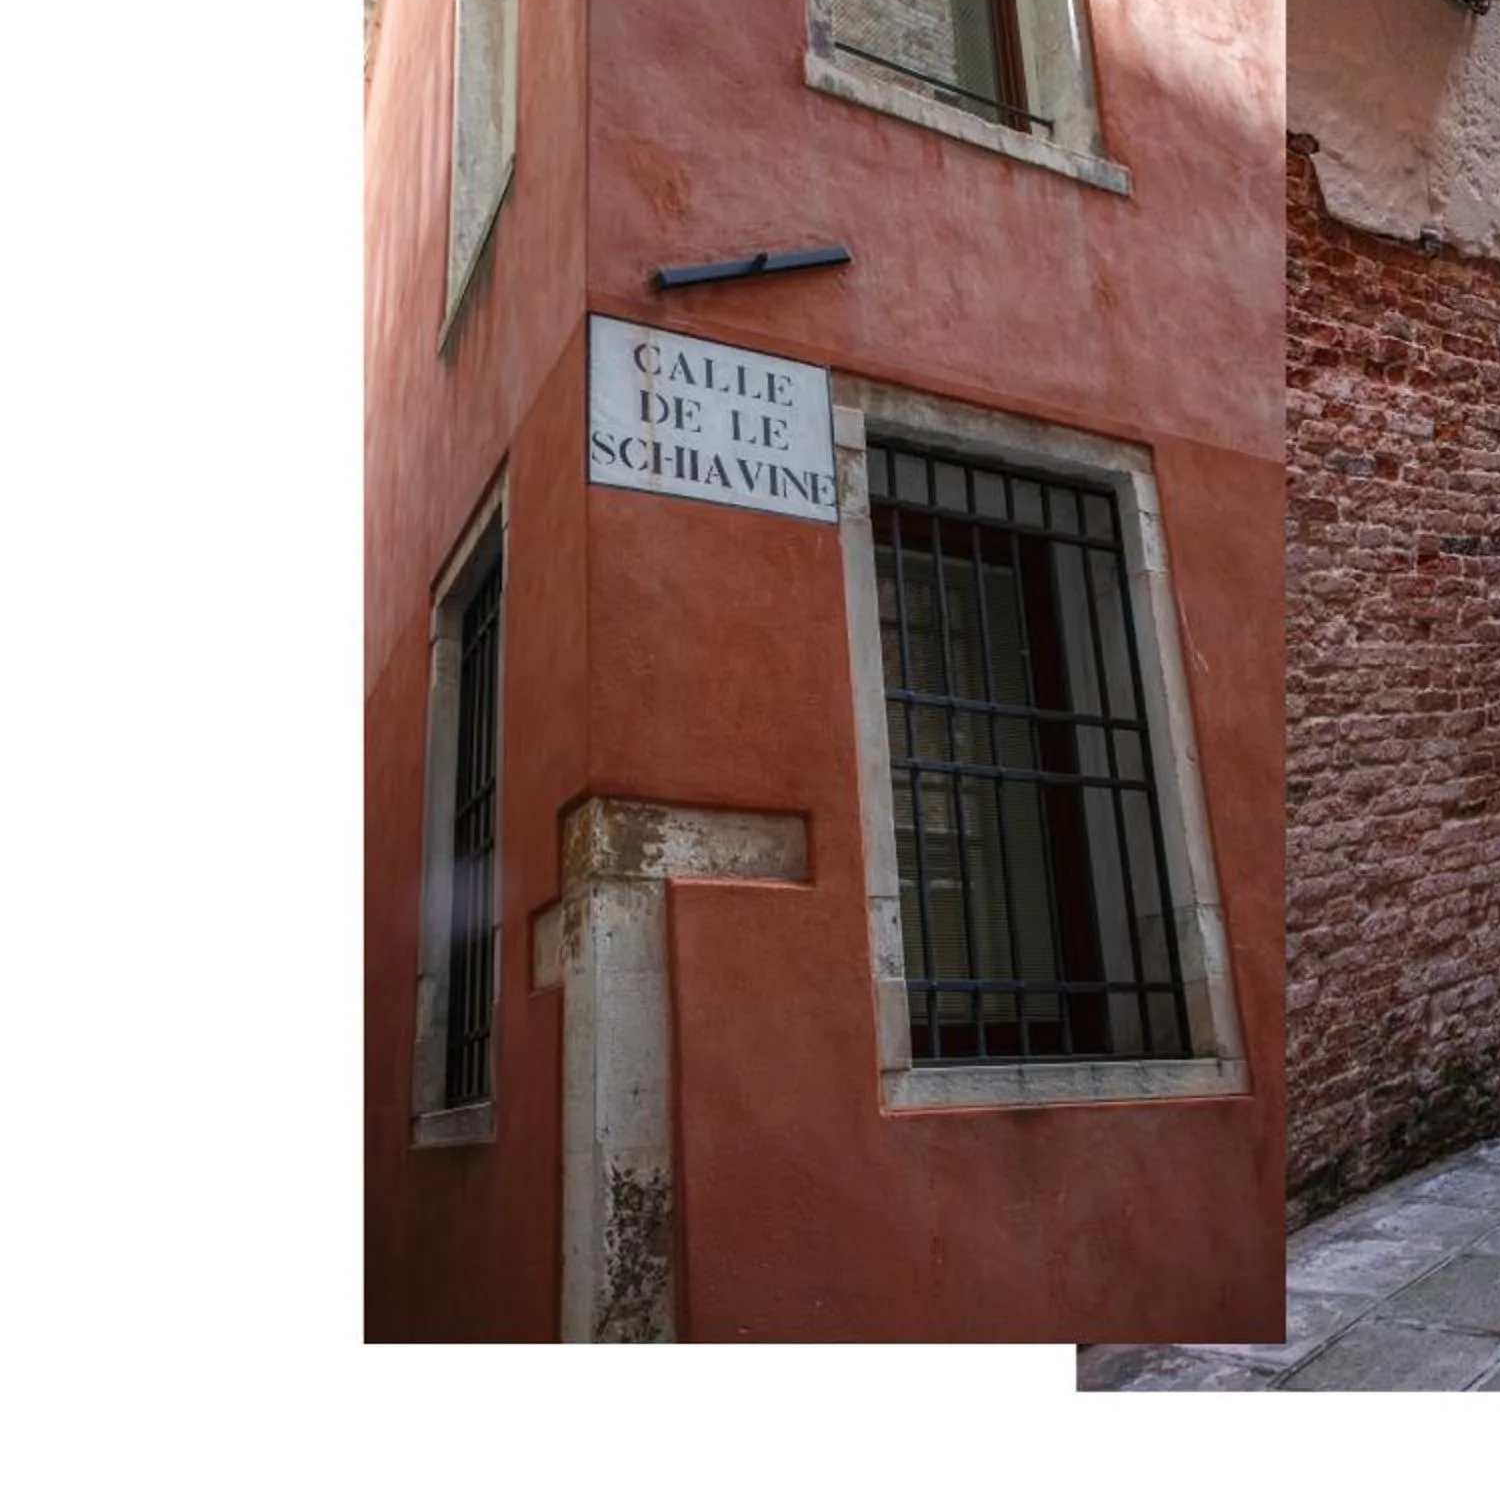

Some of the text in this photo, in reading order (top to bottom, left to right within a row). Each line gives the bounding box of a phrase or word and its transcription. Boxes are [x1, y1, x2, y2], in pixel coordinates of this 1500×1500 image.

[633, 342, 794, 408] CALLE
[639, 389, 790, 451] DE LE
[591, 430, 837, 507] SCHIAVINE
